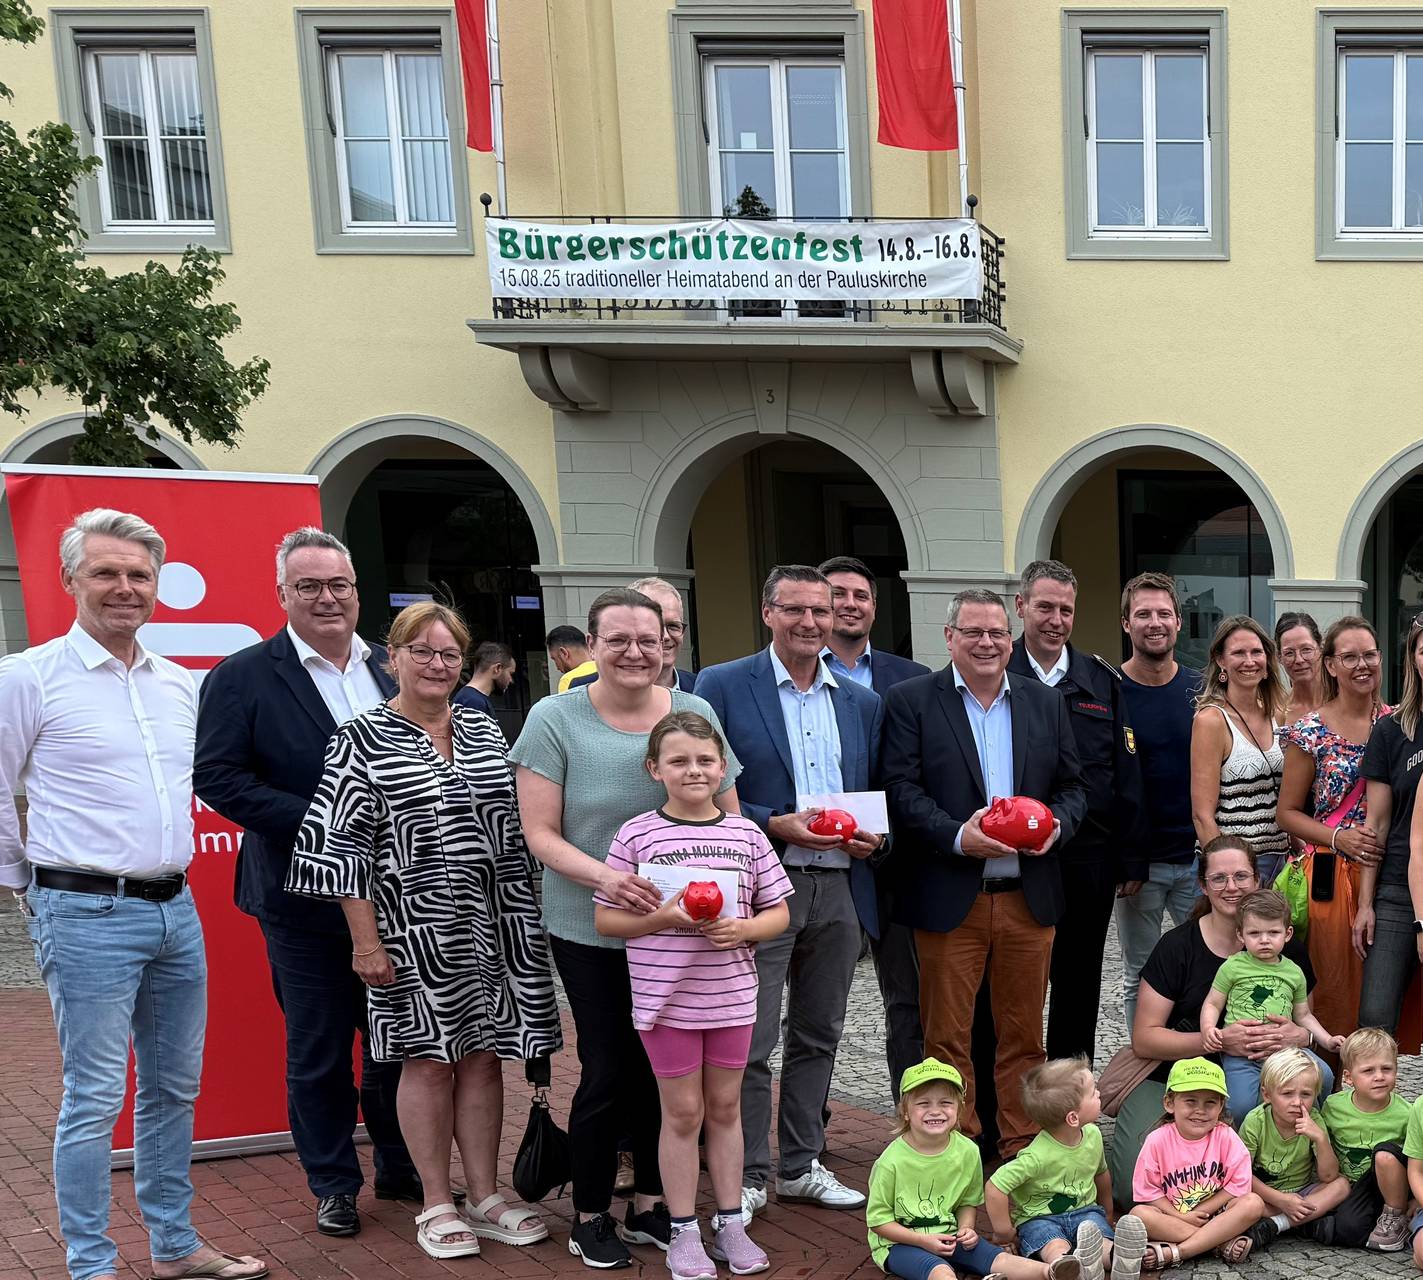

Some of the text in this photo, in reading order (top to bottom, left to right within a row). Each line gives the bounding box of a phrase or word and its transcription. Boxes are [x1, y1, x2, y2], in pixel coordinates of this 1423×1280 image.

[498, 227, 863, 262] Bürgerschützenfest
[500, 268, 927, 288] 15.08.25 traditioneller Heimatabend an der Pauluskirche
[766, 389, 775, 404] 3
